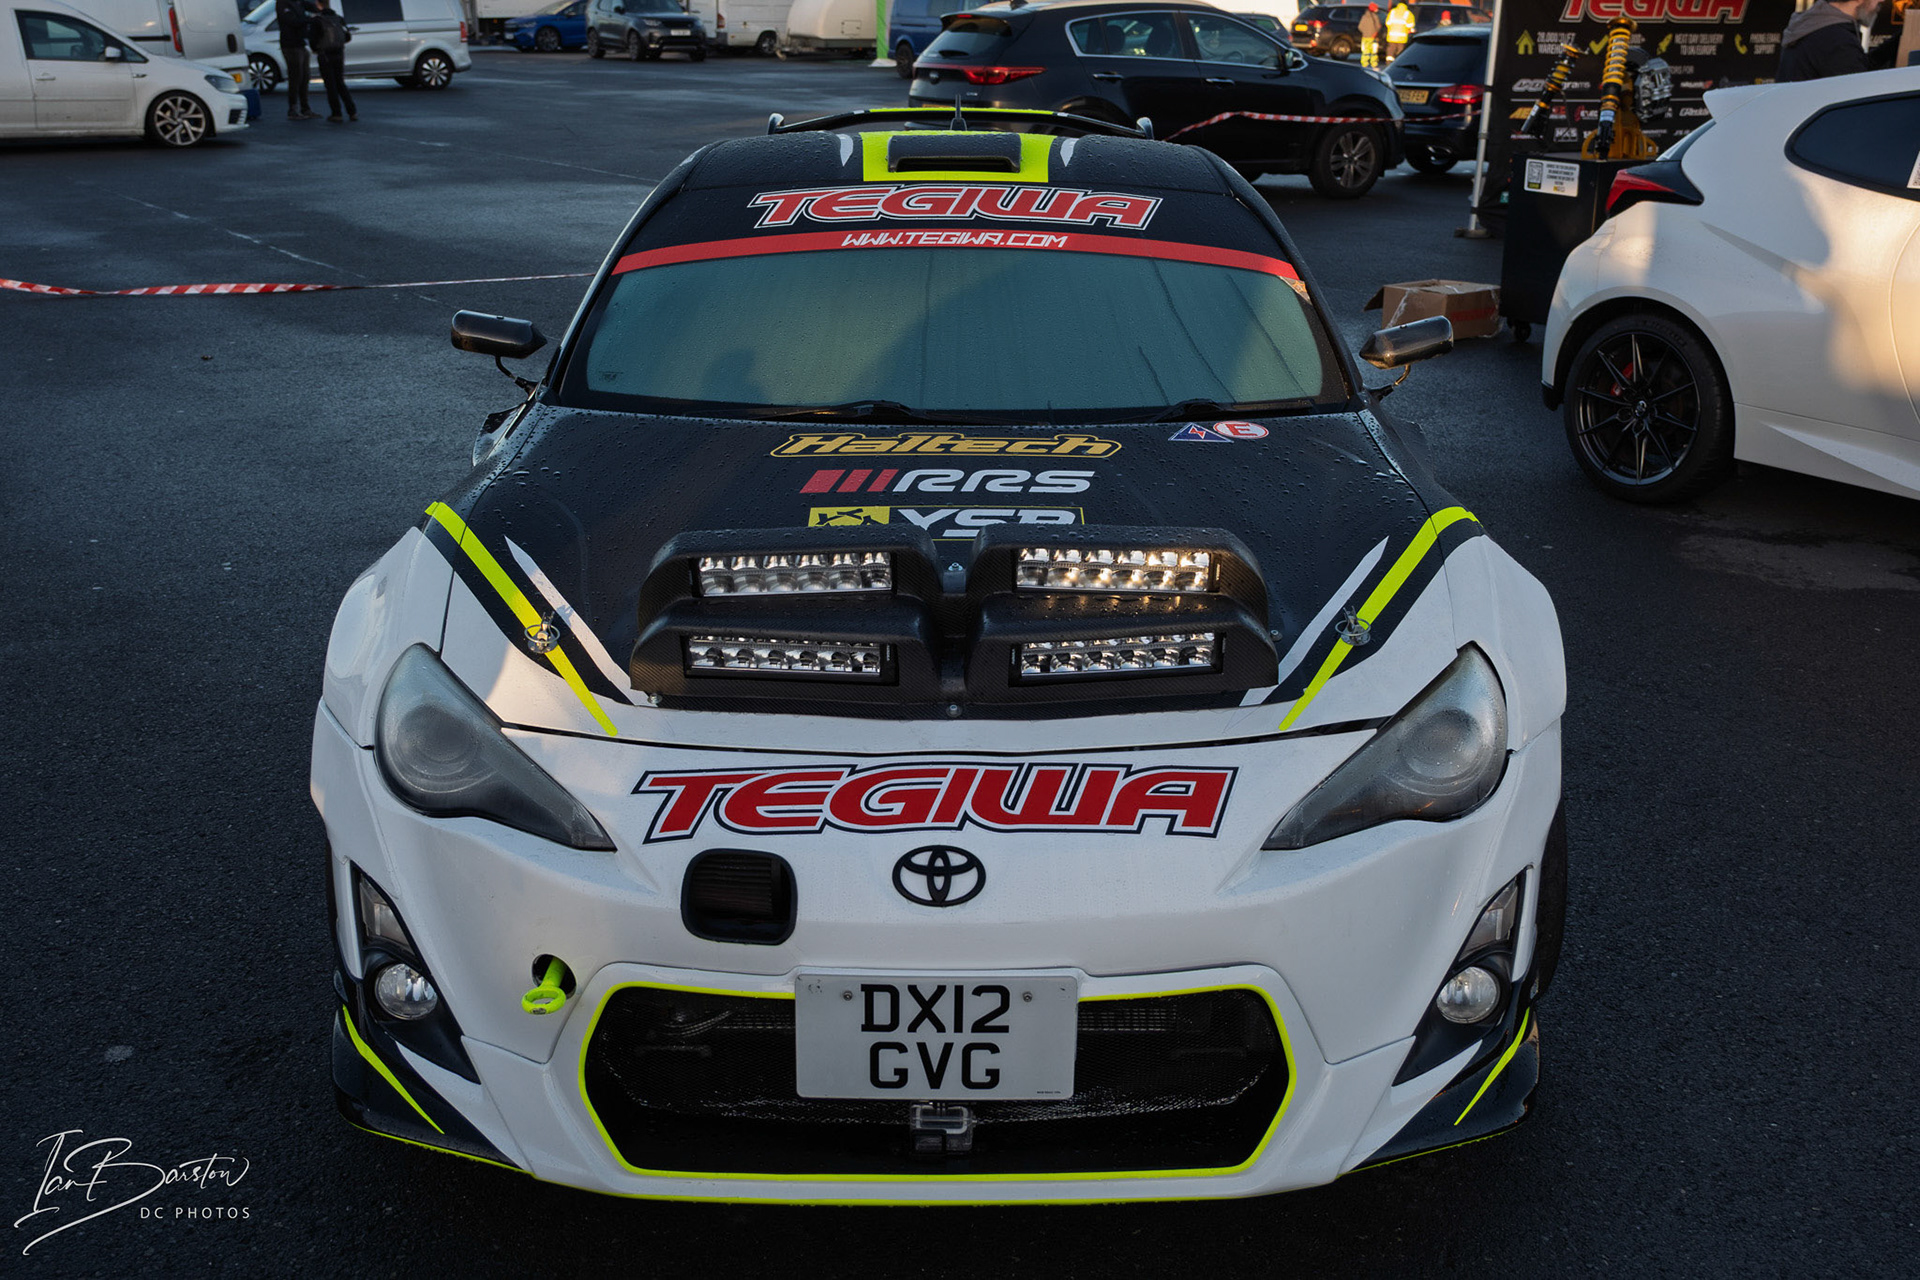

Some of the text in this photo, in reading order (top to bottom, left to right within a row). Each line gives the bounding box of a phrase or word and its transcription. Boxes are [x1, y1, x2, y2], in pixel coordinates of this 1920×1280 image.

[747, 183, 1163, 231] TEGIWA
[841, 231, 1069, 249] WWW.TEGIWA.COM
[770, 432, 1122, 459] Haltech
[892, 468, 1095, 494] RRS
[631, 762, 1238, 844] TEGIWA
[861, 984, 1010, 1033] DX12
[869, 1041, 1001, 1090] GVG
